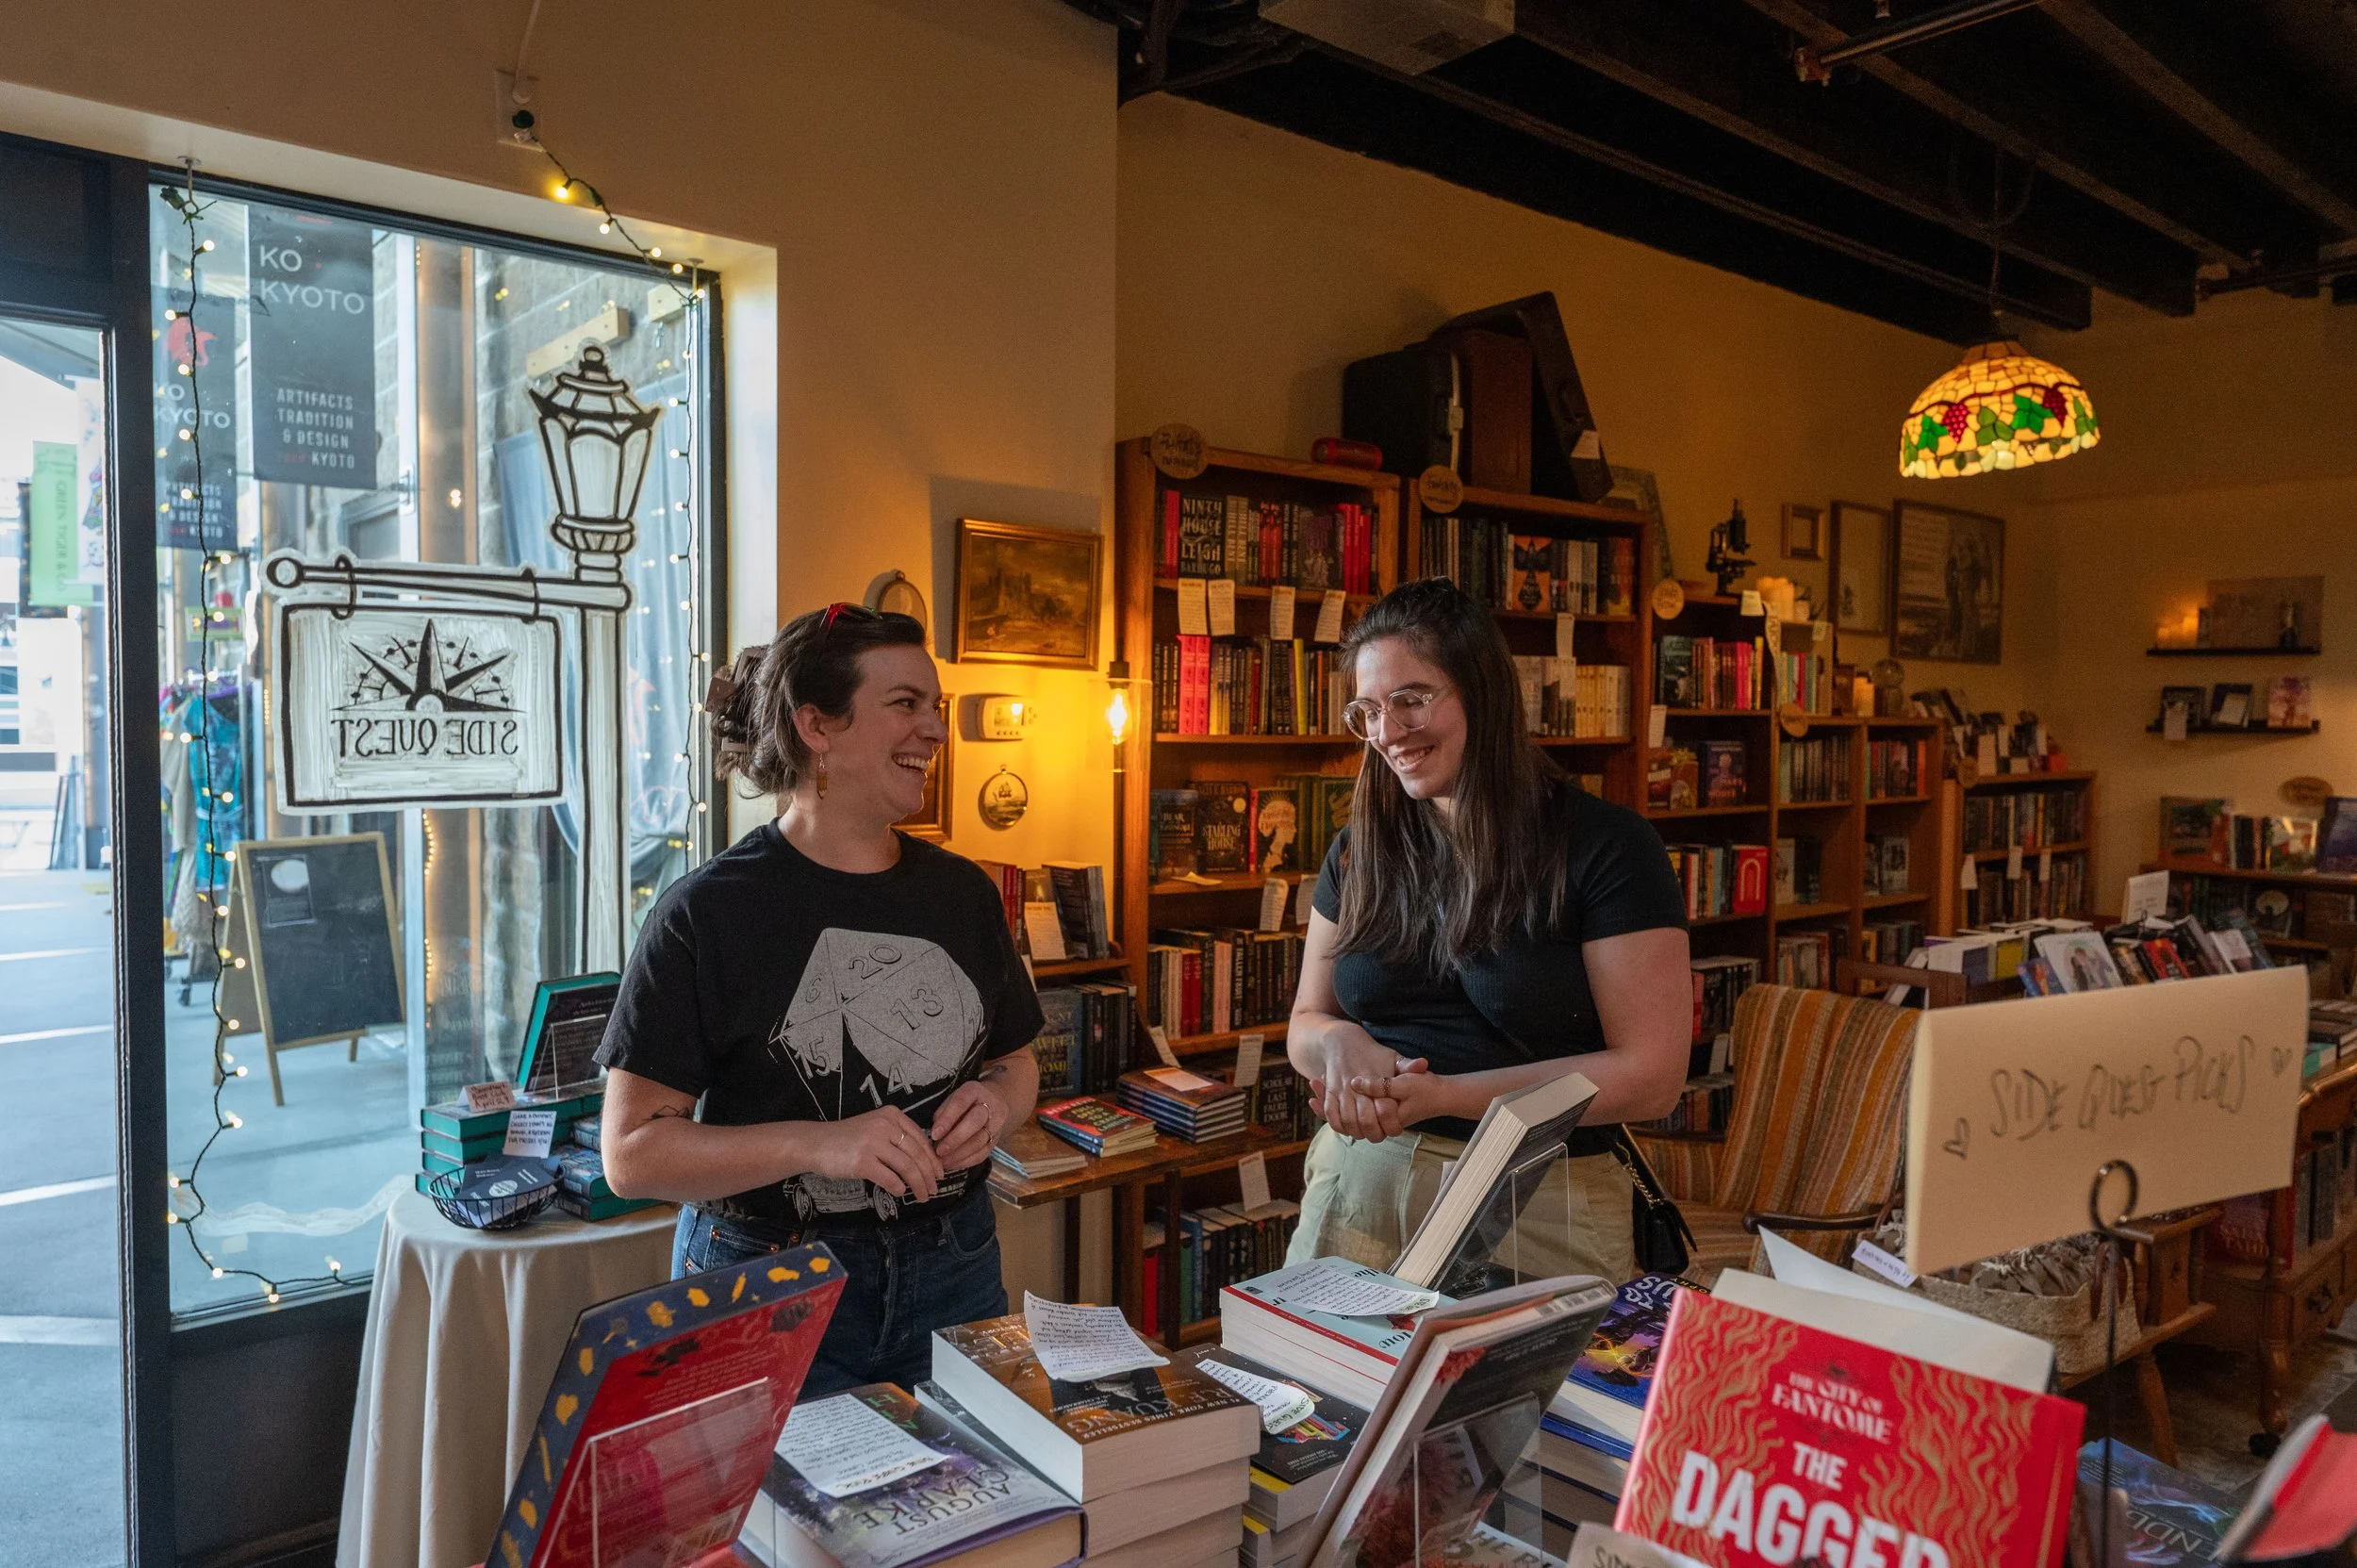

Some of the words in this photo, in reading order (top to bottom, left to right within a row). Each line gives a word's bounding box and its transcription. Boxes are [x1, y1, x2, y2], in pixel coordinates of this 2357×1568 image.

[259, 244, 303, 272] KO
[260, 280, 365, 314] KYOTO
[277, 388, 354, 411] ARTIFACTS
[278, 407, 354, 430] TRADITION
[298, 430, 349, 449] DESIGN
[312, 453, 355, 469] KYOTO
[55, 481, 69, 520] GREEN
[1183, 498, 1223, 515] NINTH
[55, 525, 69, 560] TIGER
[1181, 543, 1221, 562] LEIGH
[1201, 823, 1241, 839] STARLING
[1208, 838, 1235, 850] HOUSE
[849, 944, 902, 980] 20
[804, 977, 822, 1003] 6
[890, 988, 944, 1031] 13
[795, 1036, 831, 1080] 15
[859, 1060, 913, 1108] 14
[1989, 1067, 2068, 1141] SIDE
[2077, 1064, 2166, 1131] QUEST
[2174, 1034, 2255, 1114] PICKS
[1350, 1267, 1379, 1279] the
[1206, 1400, 1228, 1409] NEW
[1818, 1380, 1859, 1406] CITY
[1067, 1397, 1177, 1433] KUANG
[1145, 1409, 1174, 1421] TIMES
[1178, 1402, 1204, 1413] YORK
[1792, 1443, 1848, 1491] THE
[852, 1468, 1011, 1529] CLARKE
[893, 1482, 1011, 1536] AUGUST
